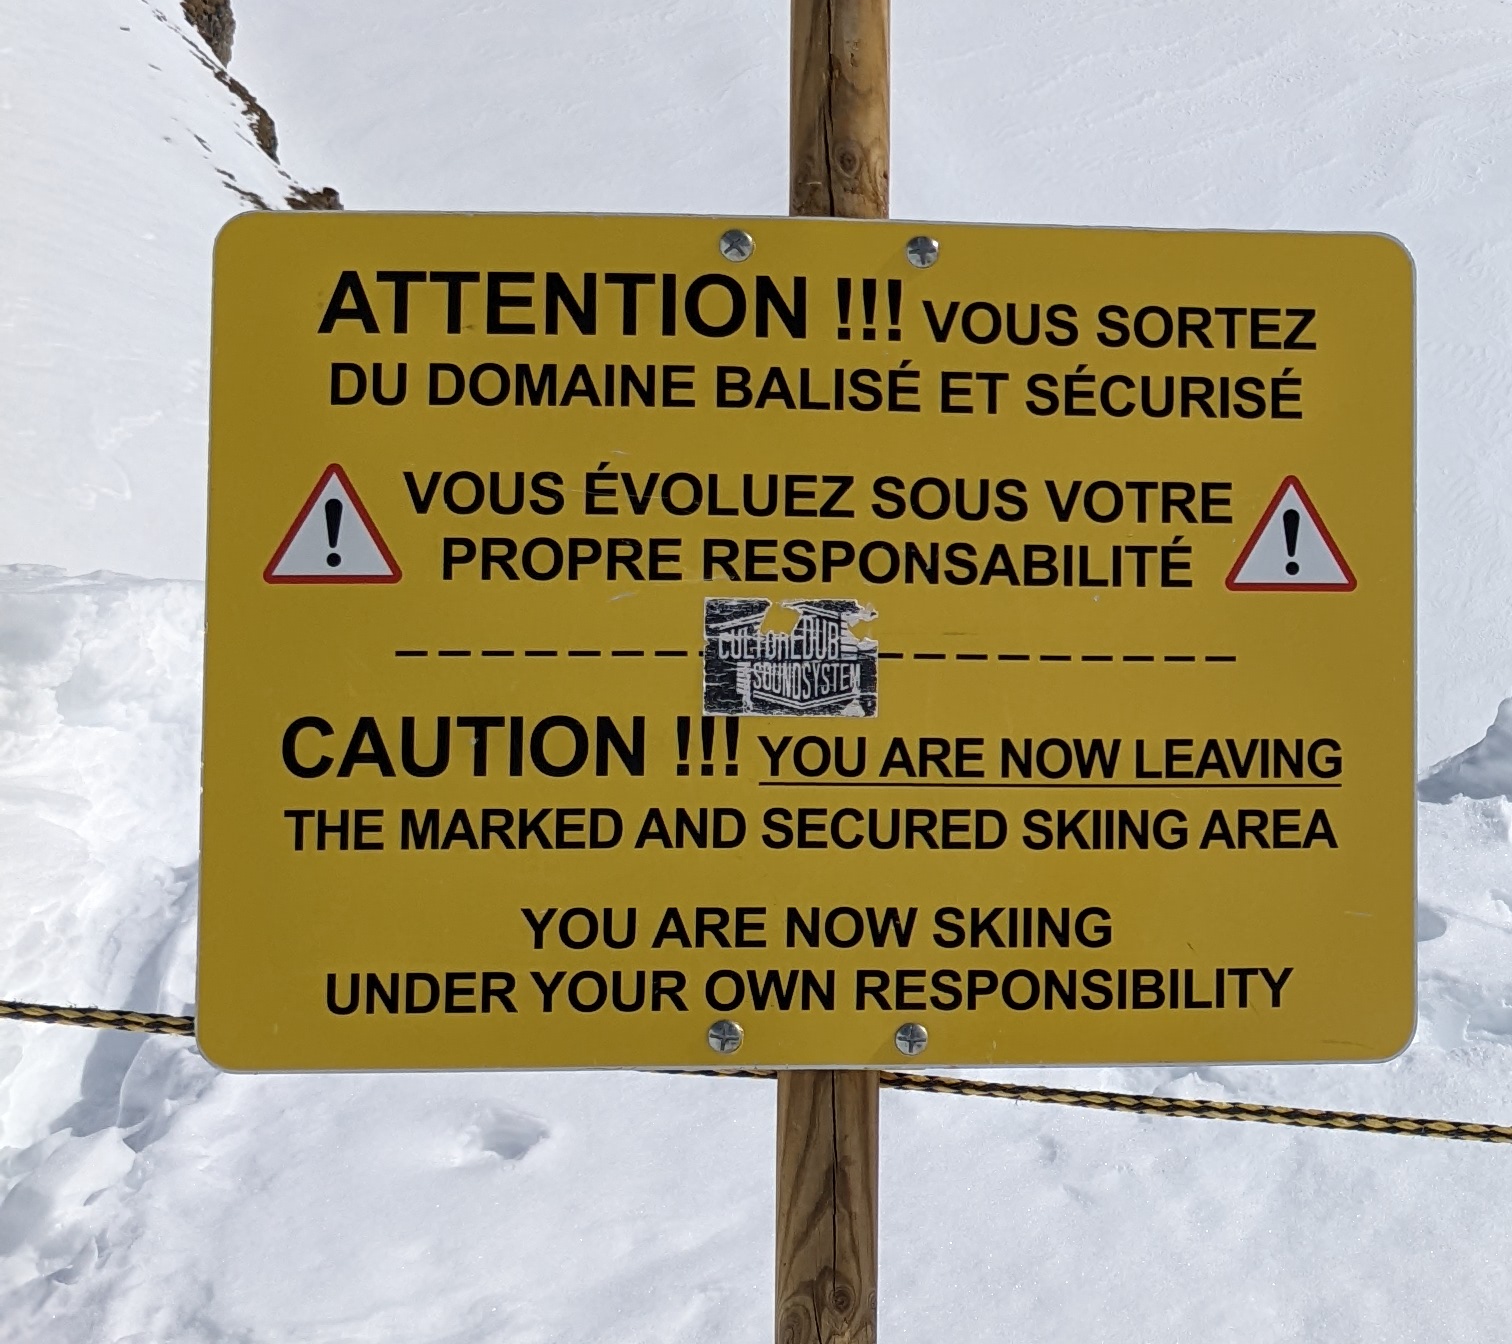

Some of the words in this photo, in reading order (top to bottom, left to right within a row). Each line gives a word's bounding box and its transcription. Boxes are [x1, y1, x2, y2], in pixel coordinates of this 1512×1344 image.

[317, 270, 807, 340] ATTENTION
[836, 277, 902, 342] !!!
[921, 299, 1079, 347] VOUS
[1096, 304, 1317, 351] SORTEZ
[330, 362, 408, 407] DU
[428, 362, 696, 408] DOMAINE
[716, 359, 921, 413] BALISÉ
[940, 370, 1010, 415] ET
[1025, 363, 1303, 420] SÉCURISÉ
[402, 470, 565, 516] VOUS
[584, 461, 855, 519] ÉVOLUEZ
[871, 475, 1029, 523] SOUS
[1044, 479, 1233, 524] VOTRE
[442, 536, 683, 582] PROPRE
[703, 534, 1193, 588] RESPONSABILITÉ
[752, 662, 861, 700] SOUNDSYSTEM
[281, 714, 646, 779] CAUTION
[676, 715, 740, 777] !!!
[756, 735, 867, 778] YOU
[878, 736, 985, 778] ARE
[1000, 737, 1122, 780] NOW
[1135, 737, 1343, 779] LEAVING
[283, 808, 385, 852] THE
[400, 807, 624, 851] MARKED
[633, 807, 747, 849] AND
[761, 807, 1008, 850] SECURED
[1022, 808, 1189, 851] SKIING
[1198, 808, 1339, 850] AREA
[520, 907, 637, 950] YOU
[650, 906, 767, 949] ARE
[786, 906, 919, 949] NOW
[932, 906, 1112, 949] SKIING
[326, 971, 519, 1016] UNDER
[529, 970, 690, 1013] YOUR
[704, 969, 836, 1012] OWN
[855, 967, 1295, 1012] RESPONSIBILITY
